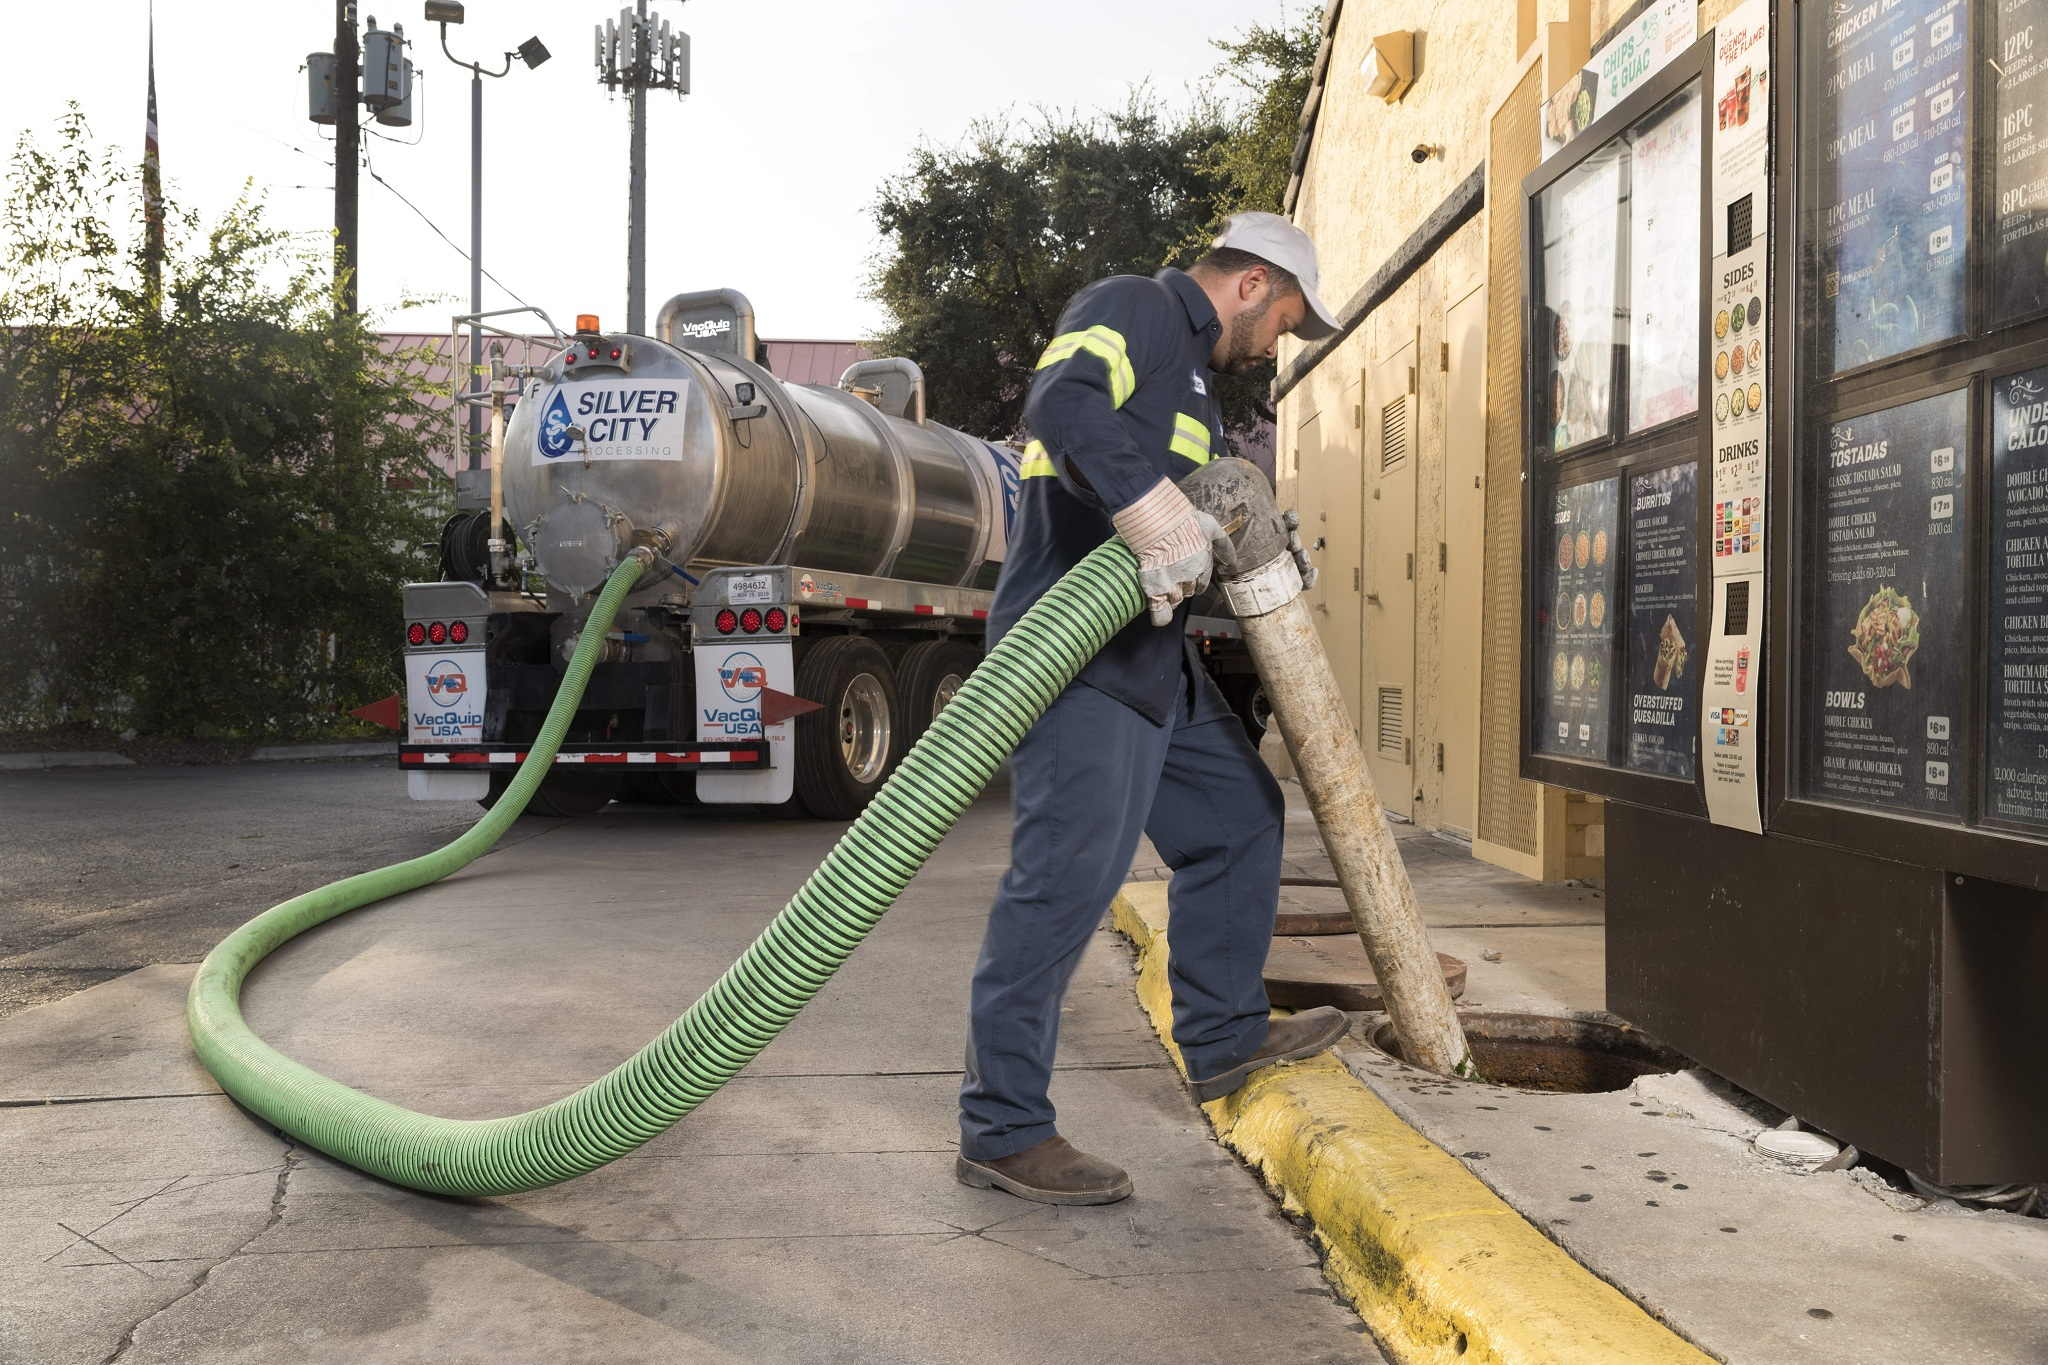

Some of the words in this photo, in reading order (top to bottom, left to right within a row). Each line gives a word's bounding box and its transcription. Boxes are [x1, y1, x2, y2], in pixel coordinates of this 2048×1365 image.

[1828, 1, 1878, 48] CHICKEN
[1924, 8, 1942, 24] BREAST
[1719, 27, 1747, 60] QUENCH
[1724, 49, 1738, 66] THE
[1740, 24, 1765, 56] FLAME!
[1952, 34, 1962, 52] cal
[2004, 26, 2032, 62] 12PC
[1604, 36, 1634, 80] CHIPS
[2004, 56, 2028, 76] FEEDS
[2028, 52, 2034, 62] 6
[1612, 76, 1618, 98] &
[1622, 48, 1650, 88] GUAC
[1828, 70, 1846, 98] 2PC
[1848, 52, 1876, 84] MEAL
[1911, 60, 1919, 76] cal
[2005, 79, 2012, 90] +3
[2013, 64, 2038, 87] LARGE
[1924, 81, 1942, 98] BREAST
[1890, 106, 1898, 117] LEG
[1952, 110, 1960, 127] cal
[2004, 104, 2032, 140] 16PC
[1827, 136, 1846, 162] 3PC
[1848, 120, 1876, 152] MEAL
[1910, 132, 1918, 149] cal
[2004, 135, 2026, 154] FEEDS
[2004, 156, 2011, 166] +3
[2012, 144, 2036, 164] LARGE
[1952, 185, 1960, 202] cal
[2002, 184, 2026, 214] 8PC
[1827, 202, 1846, 226] 4PC
[1848, 188, 1876, 218] MEAL
[1827, 226, 1842, 239] HALF
[1843, 214, 1870, 232] CHICKEN
[2002, 211, 2026, 230] FEEDS
[2027, 210, 2032, 219] 4
[2002, 220, 2044, 244] TORTILLAS
[1827, 236, 1843, 248] MEAL
[1946, 248, 1954, 265] cal
[1724, 262, 1754, 289] SIDES
[531, 383, 541, 398] F
[578, 390, 679, 415] SILVER
[589, 418, 660, 442] CITY
[578, 446, 671, 456] PROCESSING
[1719, 439, 1758, 464] DRINKS
[1830, 441, 1887, 468] TOSTADAS
[1829, 473, 1852, 488] CLASSIC
[1853, 468, 1880, 482] TOSTADA
[1881, 464, 1902, 478] SALAD
[1932, 476, 1944, 490] 830
[1944, 472, 1953, 487] cal
[2007, 470, 2037, 488] DOUBLE
[1637, 491, 1671, 510] BURRITOS
[2007, 486, 2044, 504] AVOCADO
[1555, 510, 1570, 524] SIDES
[2007, 506, 2028, 516] Double
[1828, 516, 1850, 528] DOUBLE
[1851, 512, 1876, 526] CHICKEN
[1928, 522, 1943, 536] 1000
[1944, 519, 1952, 534] cal
[1829, 528, 1854, 542] TOSTADA
[1855, 526, 1874, 540] SALAD
[2006, 536, 2040, 552] CHICKEN
[1652, 549, 1666, 560] CHICKEN
[1667, 546, 1684, 558] AVOCADO
[2006, 553, 2044, 568] TORTILLA
[1828, 570, 1852, 584] Dressing
[1852, 567, 1866, 580] adds
[1866, 566, 1886, 578] 60-320
[1887, 563, 1896, 577] cal
[2006, 574, 2032, 582] Chicken,
[816, 582, 841, 591] VacQuip
[2006, 584, 2018, 594] side
[2019, 584, 2035, 592] salad
[2006, 596, 2017, 604] and
[2018, 596, 2042, 604] cilantro
[2005, 615, 2038, 630] CHICKEN
[2004, 634, 2032, 642] Chicken,
[2004, 645, 2020, 656] pico,
[2020, 645, 2037, 654] black
[2004, 664, 2048, 678] HOMEMADE
[2004, 680, 2042, 694] TORTILLA
[1634, 694, 1682, 710] OVERSTUFFED
[1826, 691, 1865, 708] BOWLS
[2004, 698, 2021, 707] Broth
[2022, 699, 2036, 708] with
[414, 712, 482, 725] VacQuip
[1634, 709, 1675, 726] QUESADILLA
[1710, 712, 1720, 720] VISA
[1824, 715, 1846, 728] DOUBLE
[1848, 716, 1872, 730] CHICKEN
[2004, 710, 2038, 720] vegetables,
[432, 726, 462, 736] USA
[725, 724, 762, 734] USA
[1633, 732, 1648, 742] CHICKEN
[1898, 747, 1908, 756] pico
[1926, 742, 1938, 754] 890
[1940, 742, 1948, 756] cal
[1824, 756, 1846, 770] GRANDE
[1848, 759, 1874, 772] AVOCADO
[1876, 762, 1902, 776] CHICKEN
[1996, 768, 2016, 782] 2,000
[2016, 767, 2047, 785] calories
[1880, 788, 1894, 796] beans
[1926, 788, 1938, 800] 780
[1938, 787, 1948, 801] cal
[2006, 783, 2033, 802] advice,
[1998, 801, 2032, 817] nutrition
